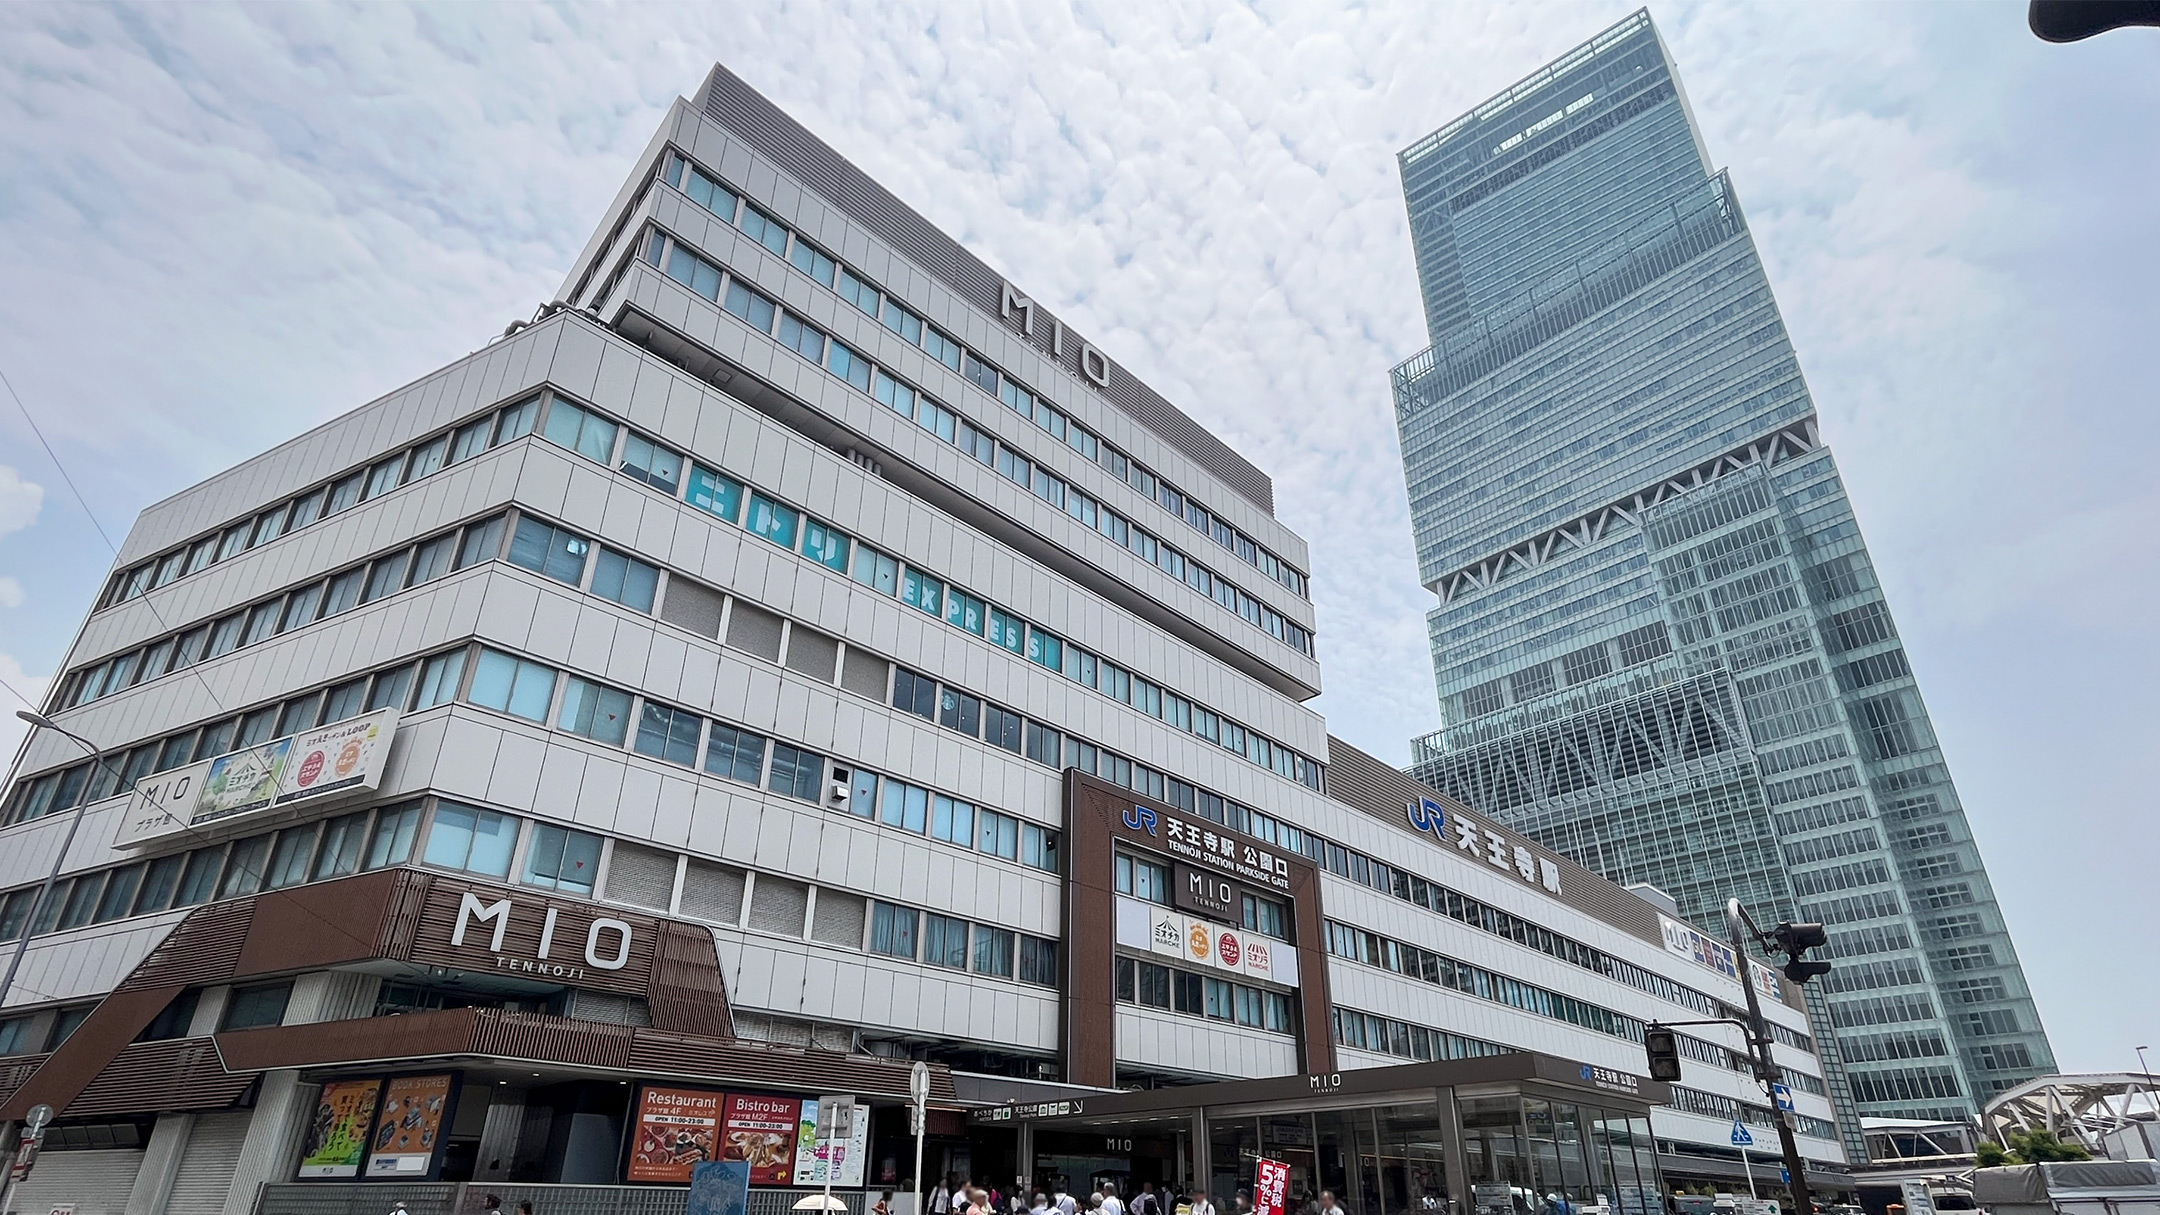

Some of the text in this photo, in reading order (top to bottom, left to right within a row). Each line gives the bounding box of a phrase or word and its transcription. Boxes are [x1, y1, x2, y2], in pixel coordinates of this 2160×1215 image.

[1002, 280, 1109, 388] MIO
[696, 474, 836, 561] ニトリ
[903, 578, 1040, 658] EXPRESS
[140, 776, 191, 810] MIO
[1123, 805, 1158, 837] JR
[1407, 796, 1447, 841] JR
[1166, 816, 1288, 877] 天王寺駅 公園口
[1453, 814, 1563, 895] 天王寺駅
[1203, 853, 1235, 870] STATION
[1236, 863, 1270, 883] PARKSIDE
[1271, 876, 1289, 889] GATE
[1189, 872, 1232, 903] MIO
[1194, 896, 1228, 912] TENNOJI
[451, 891, 633, 970] MIO
[1155, 927, 1179, 941] ミオチカ
[496, 956, 584, 980] TENNOJI
[391, 1078, 447, 1090] BOOK STORES
[1310, 1074, 1341, 1088] MIO
[1593, 1067, 1637, 1087] 天王寺駅 公園口
[647, 1091, 717, 1109] Restaurant
[670, 1107, 682, 1115] 4F
[736, 1099, 790, 1113] Bistro bar
[1014, 1104, 1037, 1114] 天王寺公園
[671, 1117, 704, 1125] 11:00-23:00
[1106, 1138, 1132, 1151] MIO
[1270, 1167, 1286, 1208] 消費税
